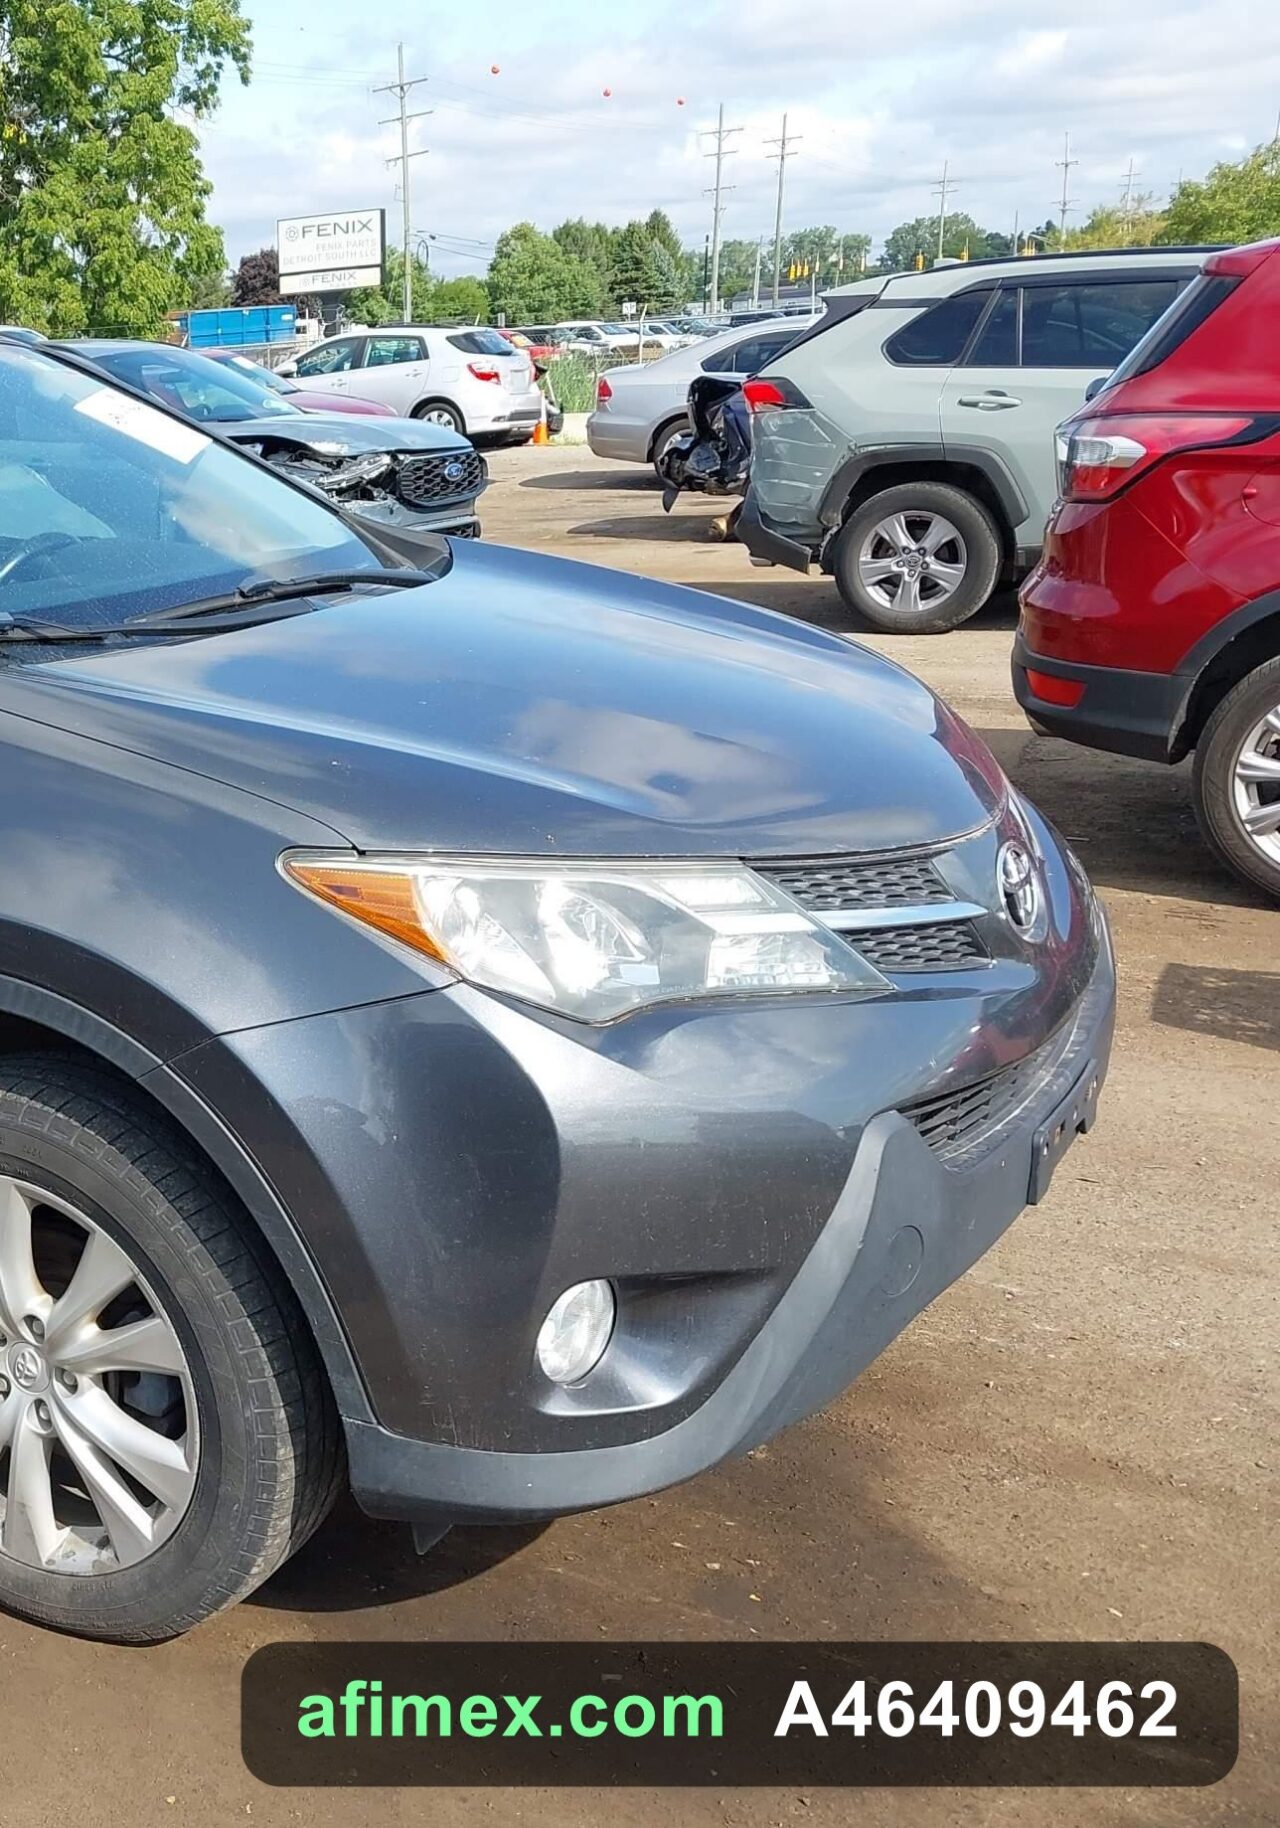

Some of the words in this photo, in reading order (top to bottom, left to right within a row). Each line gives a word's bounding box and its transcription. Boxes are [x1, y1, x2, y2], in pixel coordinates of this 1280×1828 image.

[302, 218, 373, 239] FENIX
[315, 241, 343, 252] FENIX
[346, 238, 377, 249] PARTS
[325, 250, 357, 262] SOUTH
[360, 248, 377, 258] LLC
[312, 271, 357, 284] FENIX
